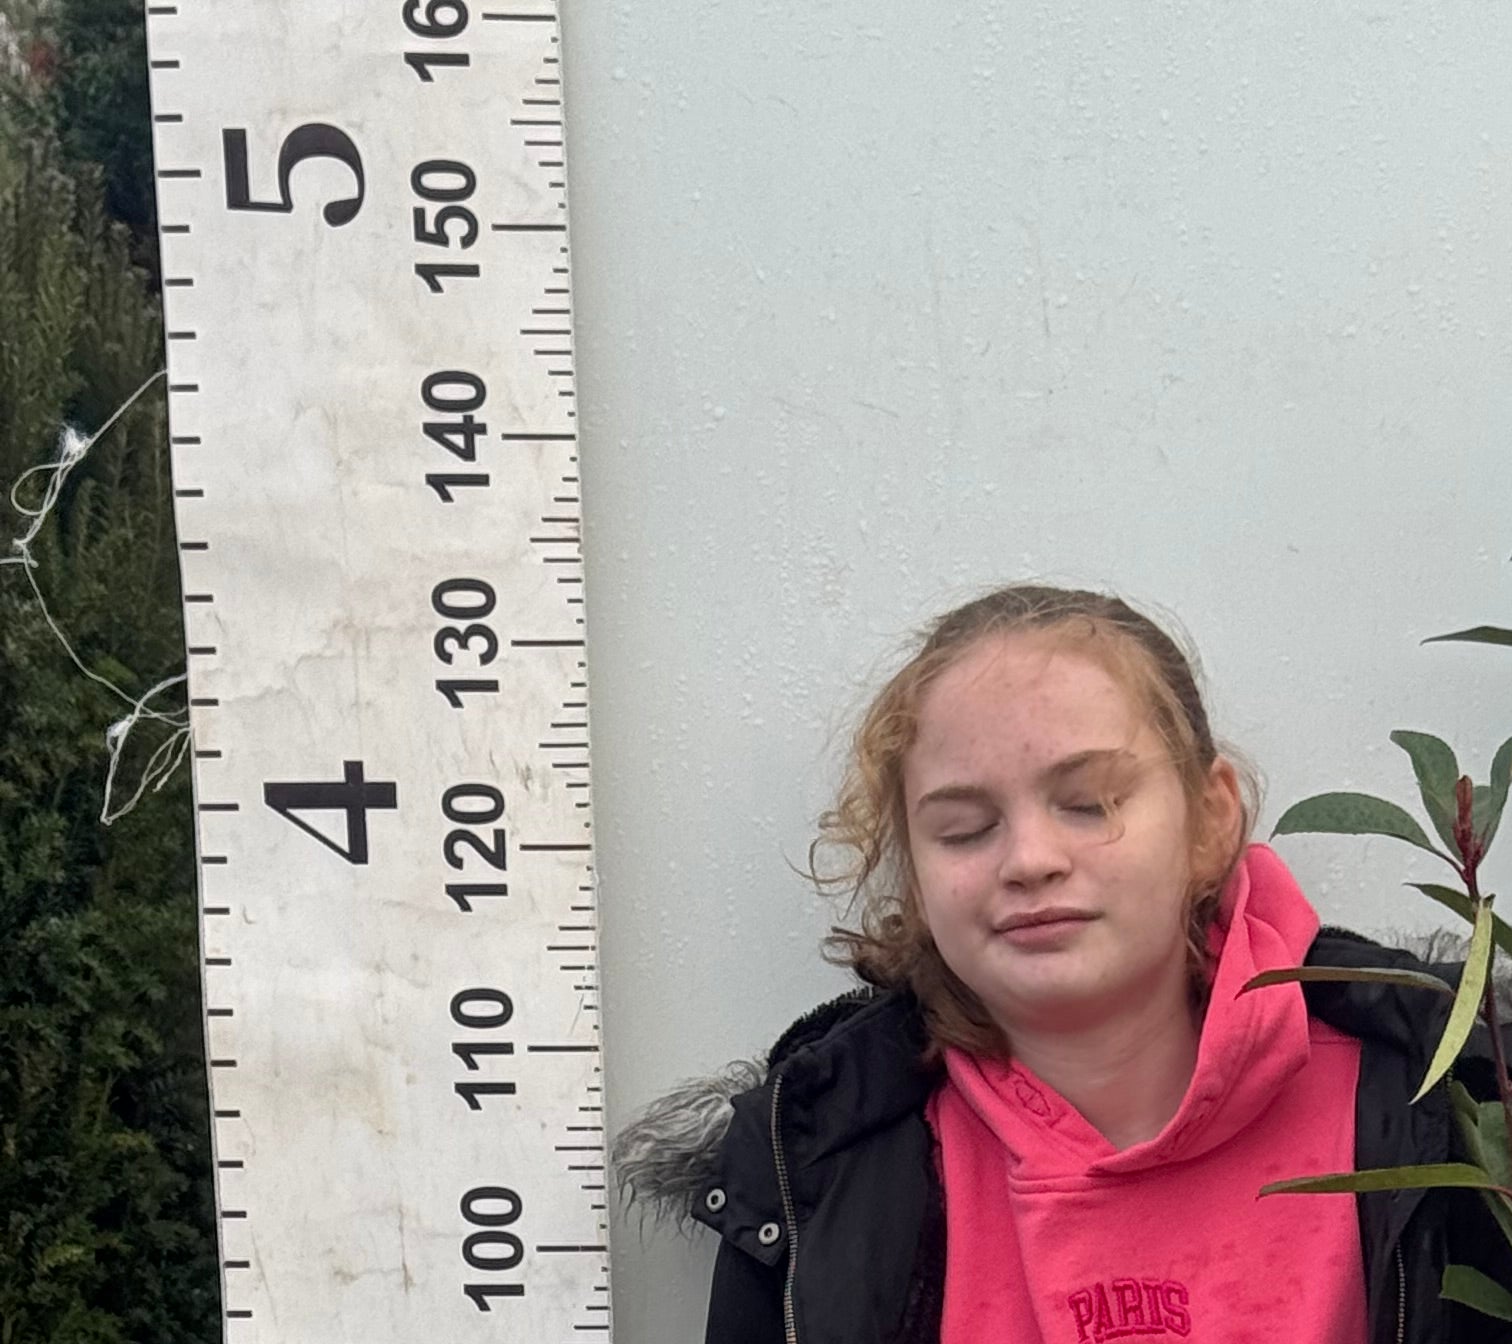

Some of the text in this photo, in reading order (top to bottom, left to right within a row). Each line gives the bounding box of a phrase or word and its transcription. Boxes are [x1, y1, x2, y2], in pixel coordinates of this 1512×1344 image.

[223, 122, 366, 228] 5
[409, 158, 480, 293] 150
[420, 370, 490, 502] 140
[431, 578, 499, 708] 130
[263, 760, 398, 865] 4
[441, 783, 508, 912] 120
[450, 988, 517, 1111] 110
[460, 1186, 525, 1312] 100
